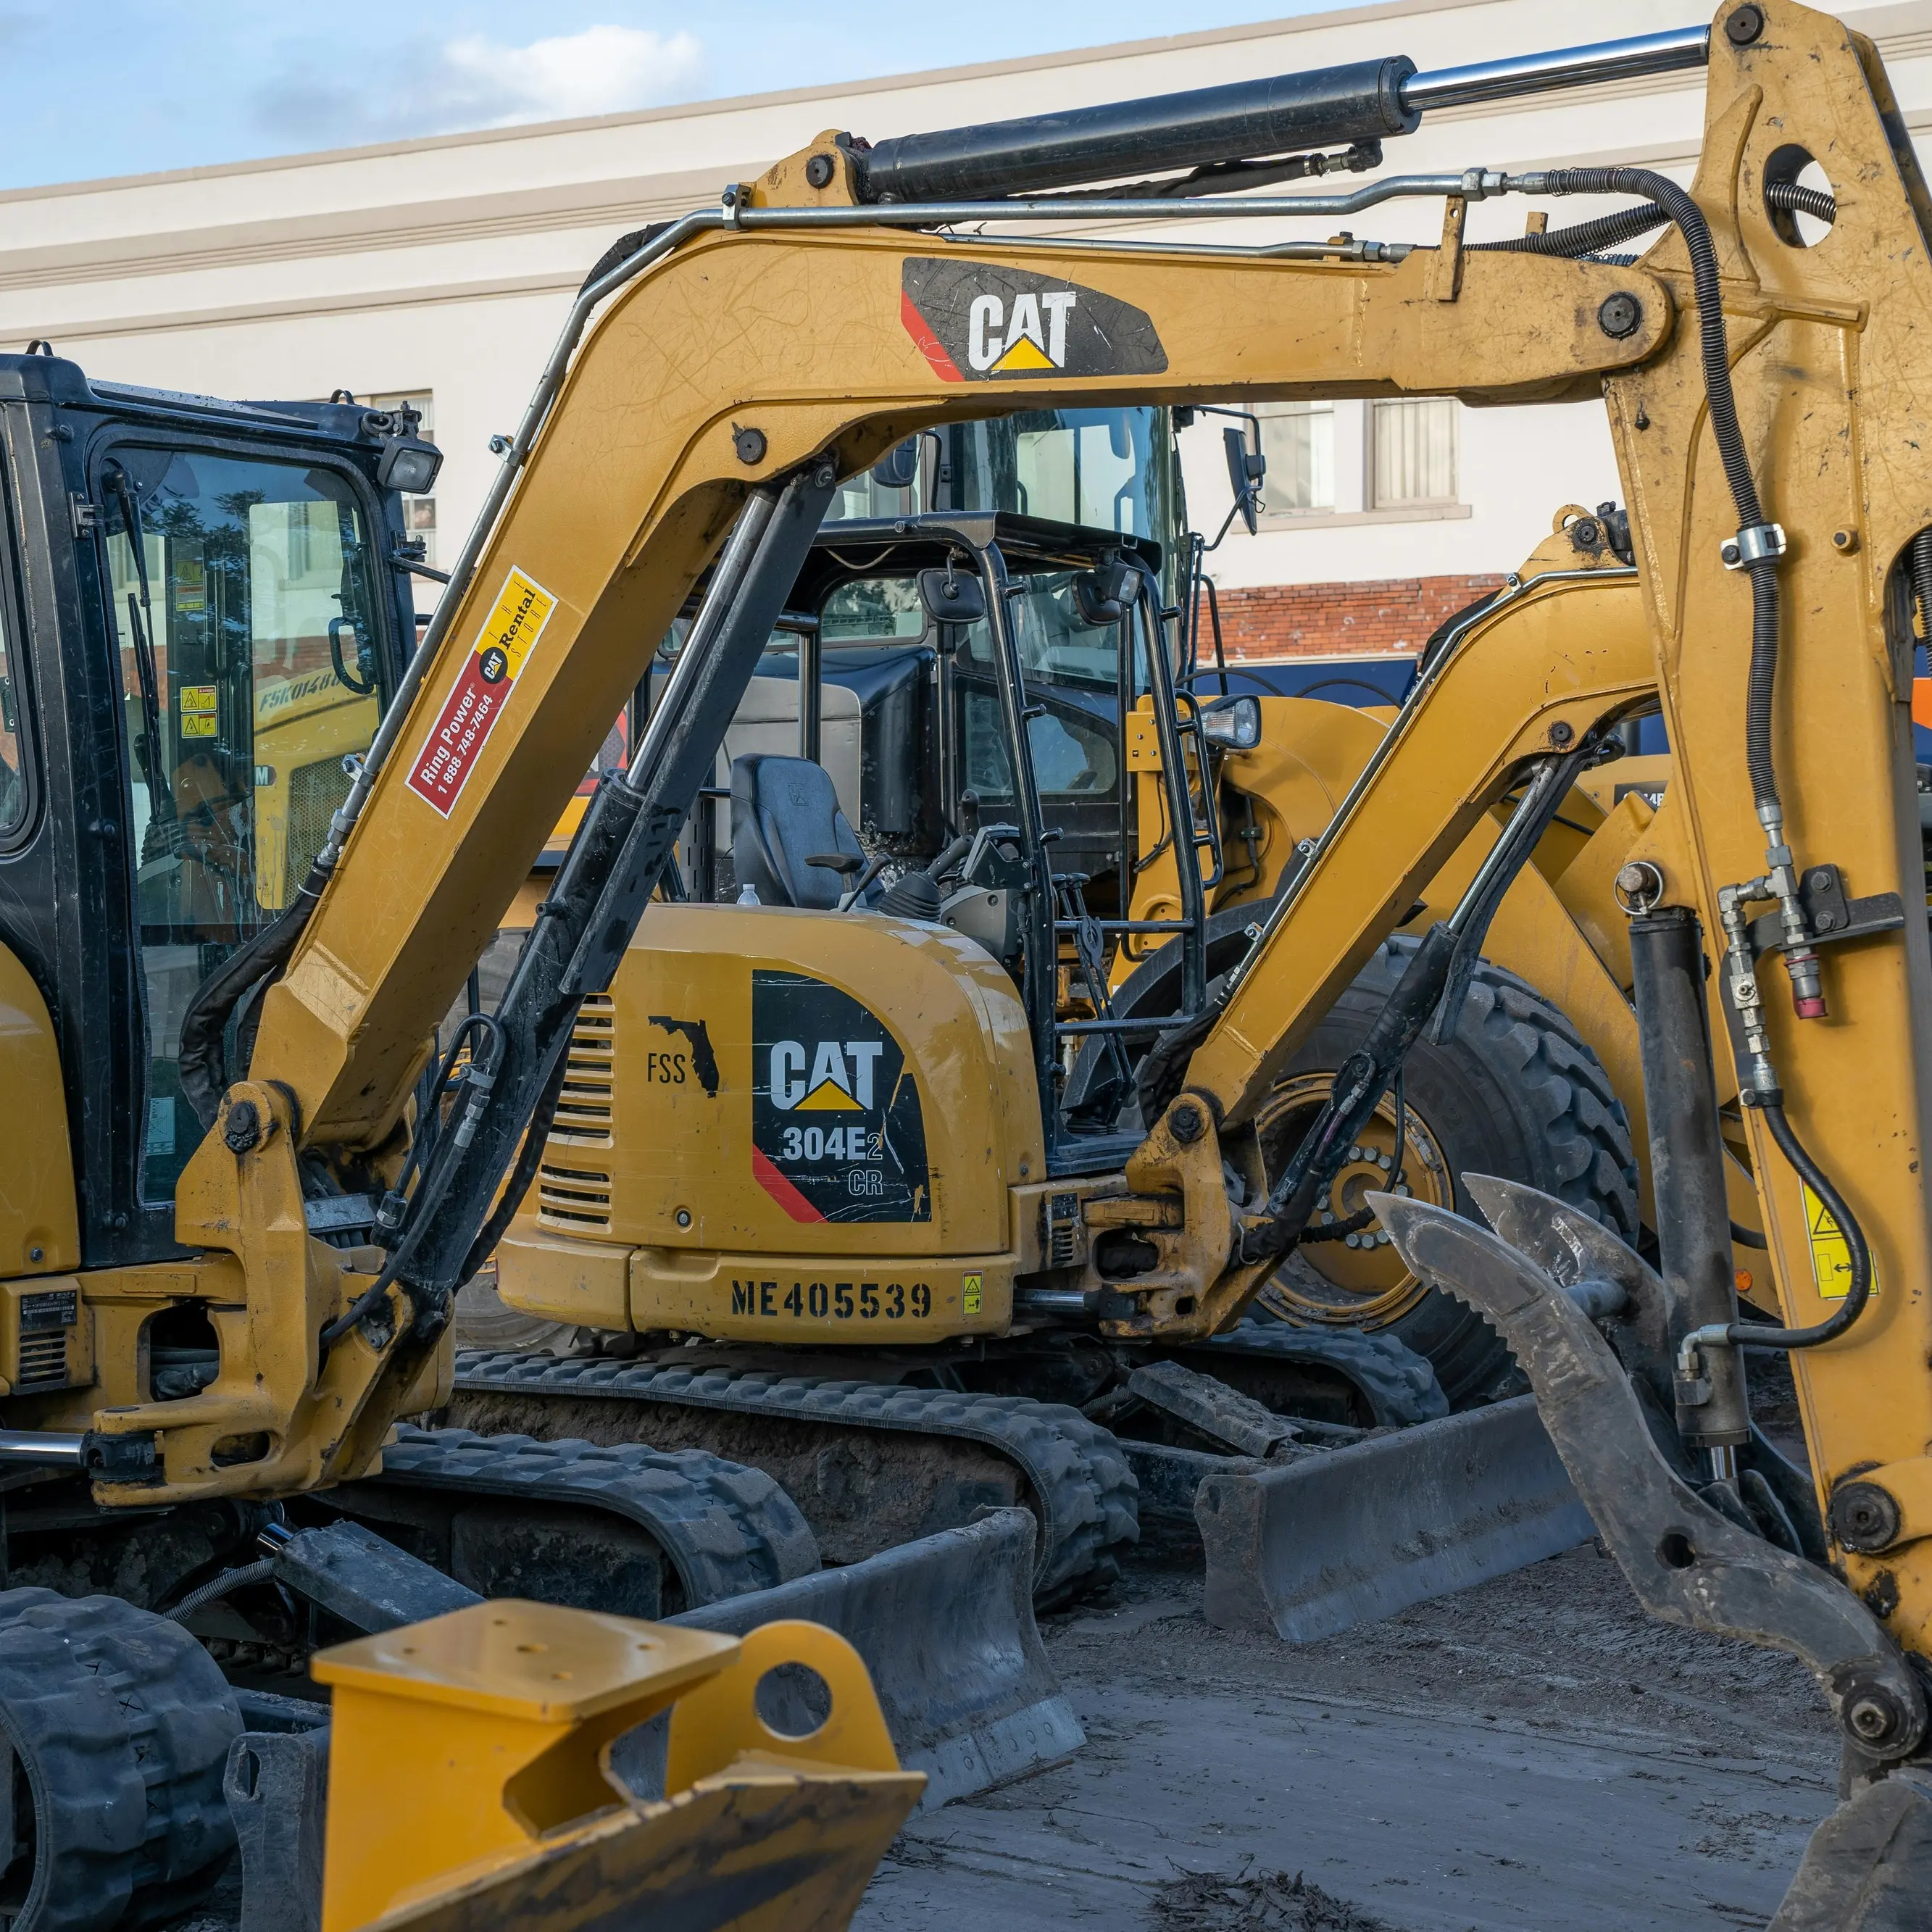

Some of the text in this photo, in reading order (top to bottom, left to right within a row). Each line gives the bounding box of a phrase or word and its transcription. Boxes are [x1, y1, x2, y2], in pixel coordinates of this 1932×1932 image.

[968, 291, 1076, 372] CAT
[484, 588, 536, 680] CAT Rental
[488, 580, 525, 640] THE
[511, 597, 548, 658] STORE
[420, 745, 451, 786] Ring
[438, 694, 494, 794] 1 888-748-7464
[647, 1052, 686, 1084] FSS
[770, 1040, 883, 1110] CAT
[783, 1126, 883, 1161] 304E2
[848, 1169, 883, 1196] CR
[731, 1279, 932, 1319] ME405539
